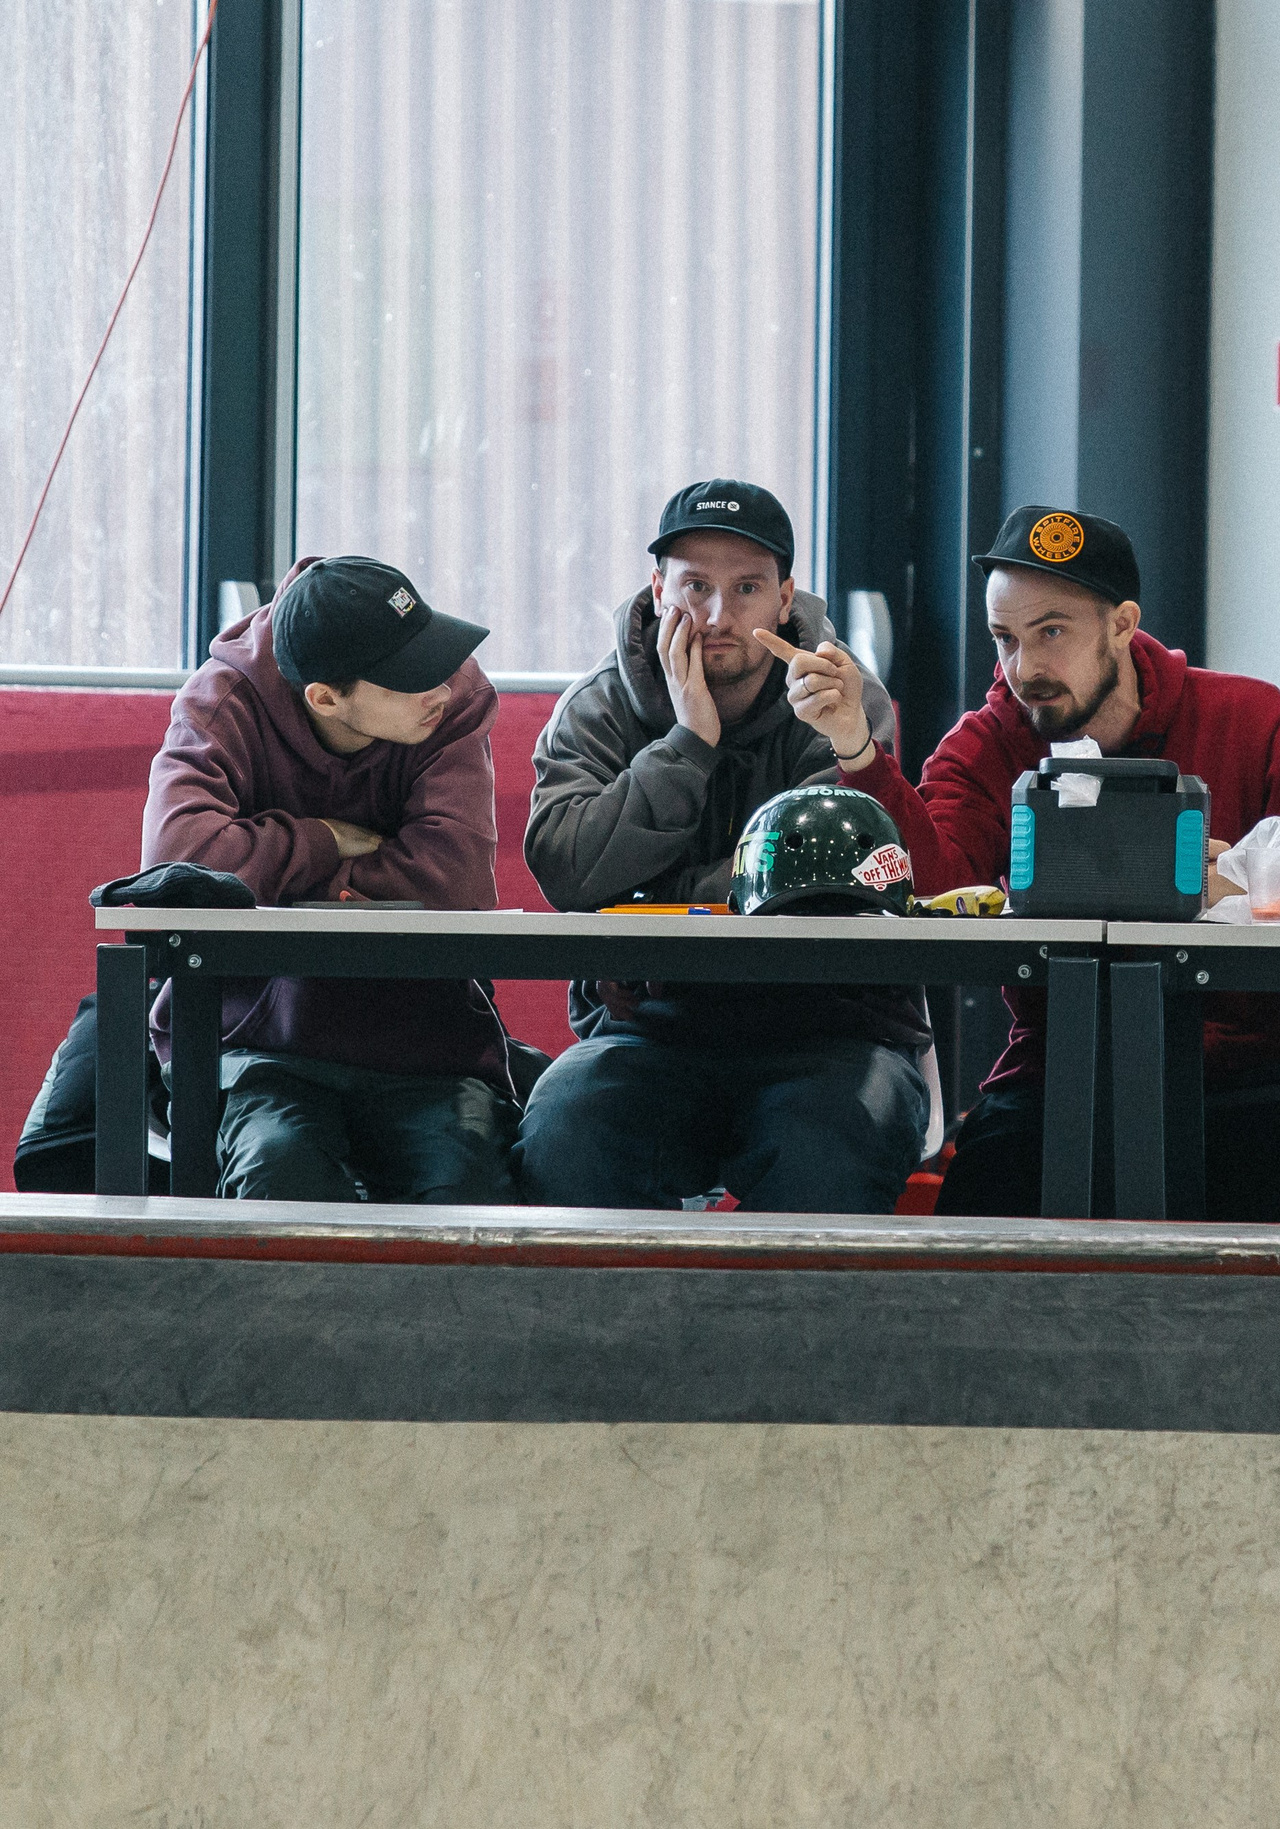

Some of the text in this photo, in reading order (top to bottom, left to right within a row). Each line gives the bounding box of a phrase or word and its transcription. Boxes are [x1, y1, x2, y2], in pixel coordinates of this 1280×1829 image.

[696, 501, 727, 511] STANCE
[1036, 516, 1080, 543] SPITFIRE
[1033, 536, 1076, 559] WHEELS
[873, 846, 899, 865] VANS
[881, 859, 900, 879] THE
